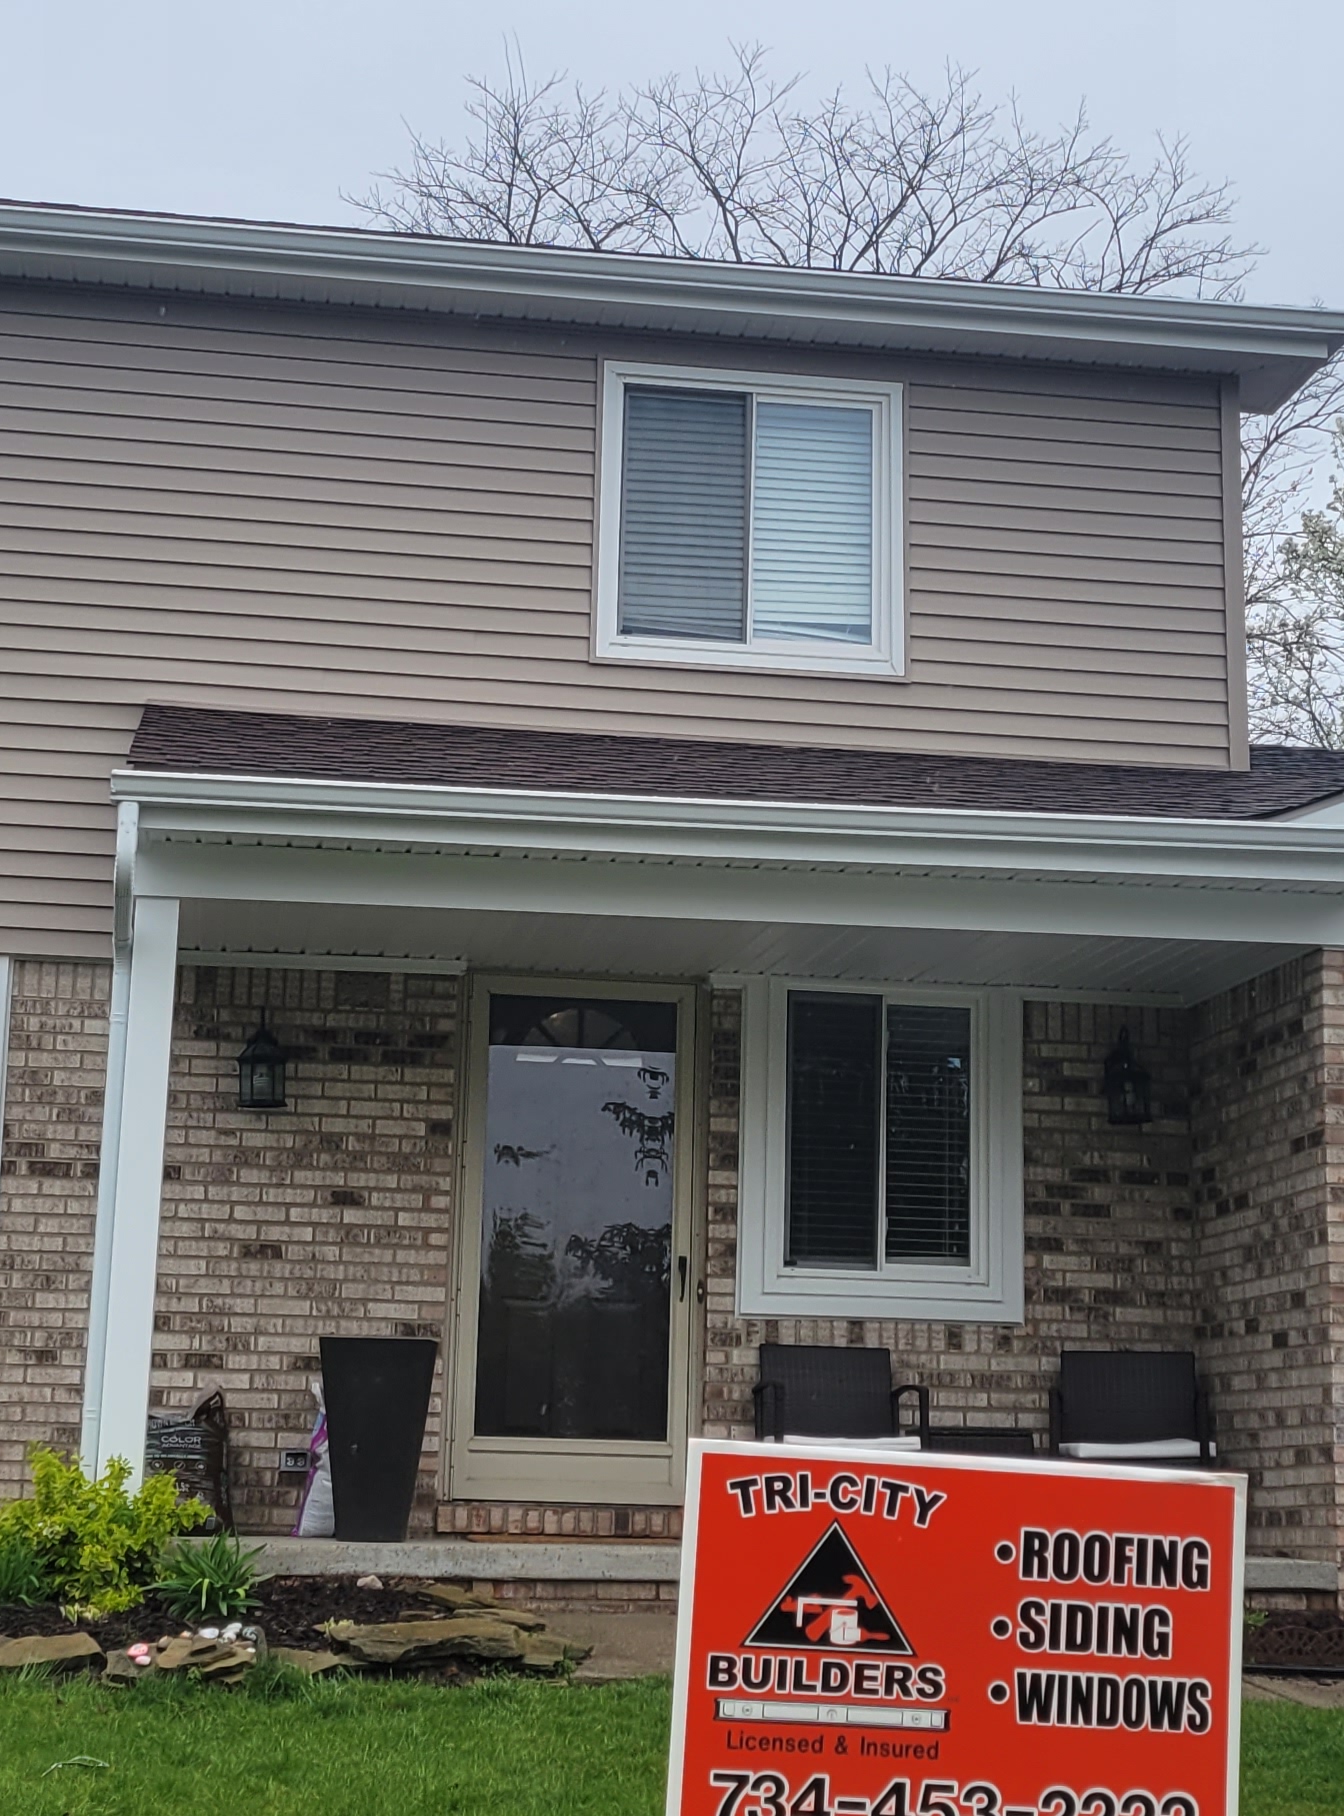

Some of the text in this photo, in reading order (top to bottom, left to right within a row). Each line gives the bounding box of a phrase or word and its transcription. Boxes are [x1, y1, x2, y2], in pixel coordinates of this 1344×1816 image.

[161, 1435, 202, 1444] COLOR
[727, 1472, 947, 1528] TRI-CITY
[1019, 1527, 1210, 1591] ROOFING
[1017, 1597, 1172, 1660] SIDING
[706, 1653, 946, 1701] BUILDERS
[1014, 1668, 1212, 1735] WINDOWS
[726, 1730, 940, 1760] Licensed & Insured
